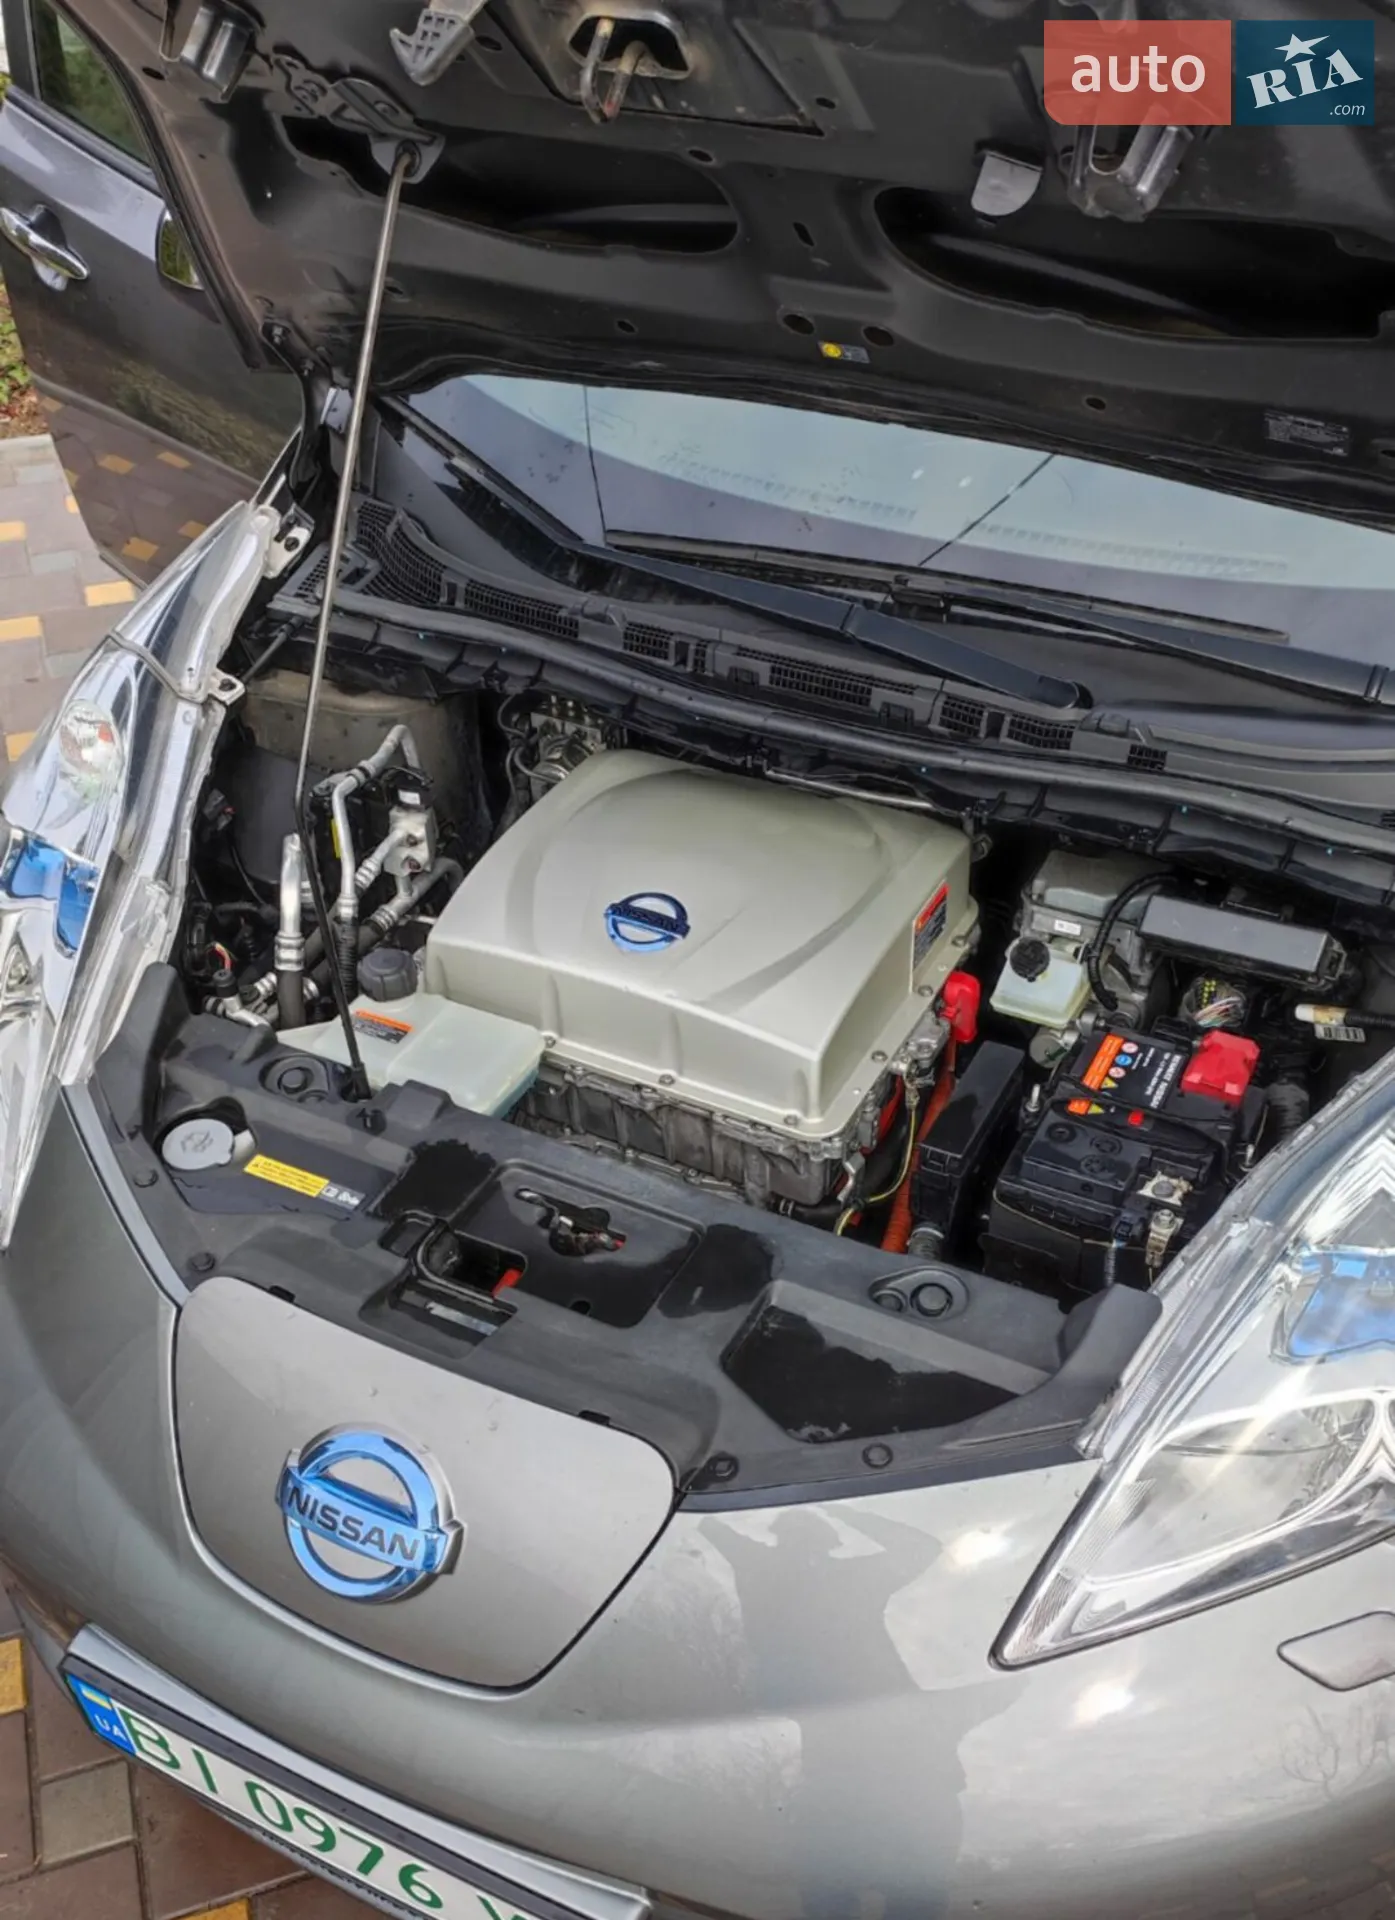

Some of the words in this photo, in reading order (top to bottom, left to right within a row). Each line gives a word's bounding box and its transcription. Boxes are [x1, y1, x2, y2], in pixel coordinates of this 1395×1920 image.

[287, 1486, 420, 1561] NISSAN
[94, 1713, 128, 1742] UA
[119, 1708, 217, 1795] BI
[244, 1780, 444, 1911] 0976
